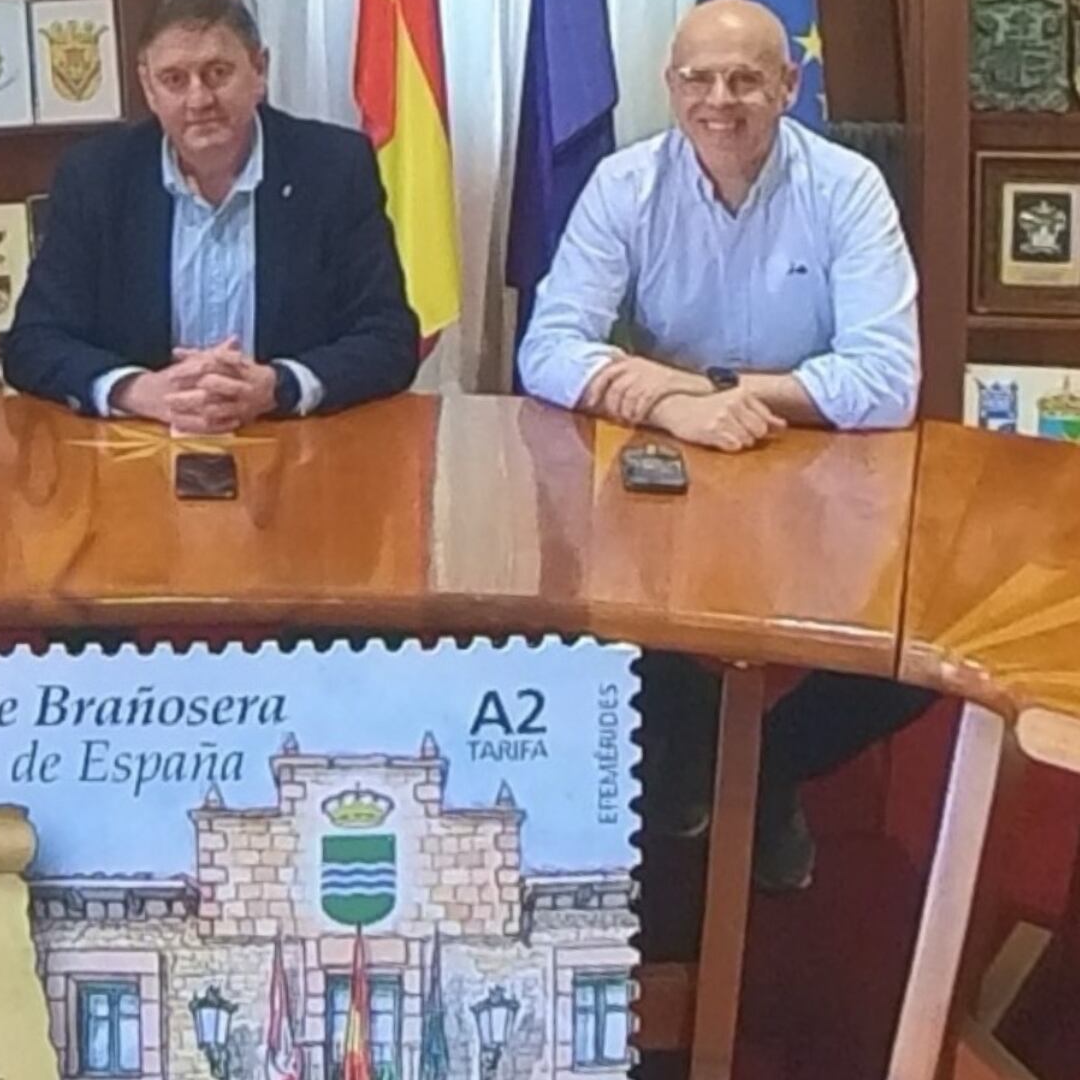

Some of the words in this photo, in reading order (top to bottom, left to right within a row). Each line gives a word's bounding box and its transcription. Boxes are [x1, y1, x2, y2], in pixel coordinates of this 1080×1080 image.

[33, 683, 289, 728] Brañosera
[469, 687, 548, 736] A2
[10, 738, 62, 784] de
[77, 738, 246, 798] España
[466, 738, 549, 762] TARIFA
[593, 682, 620, 825] EFEMÉRIDES
